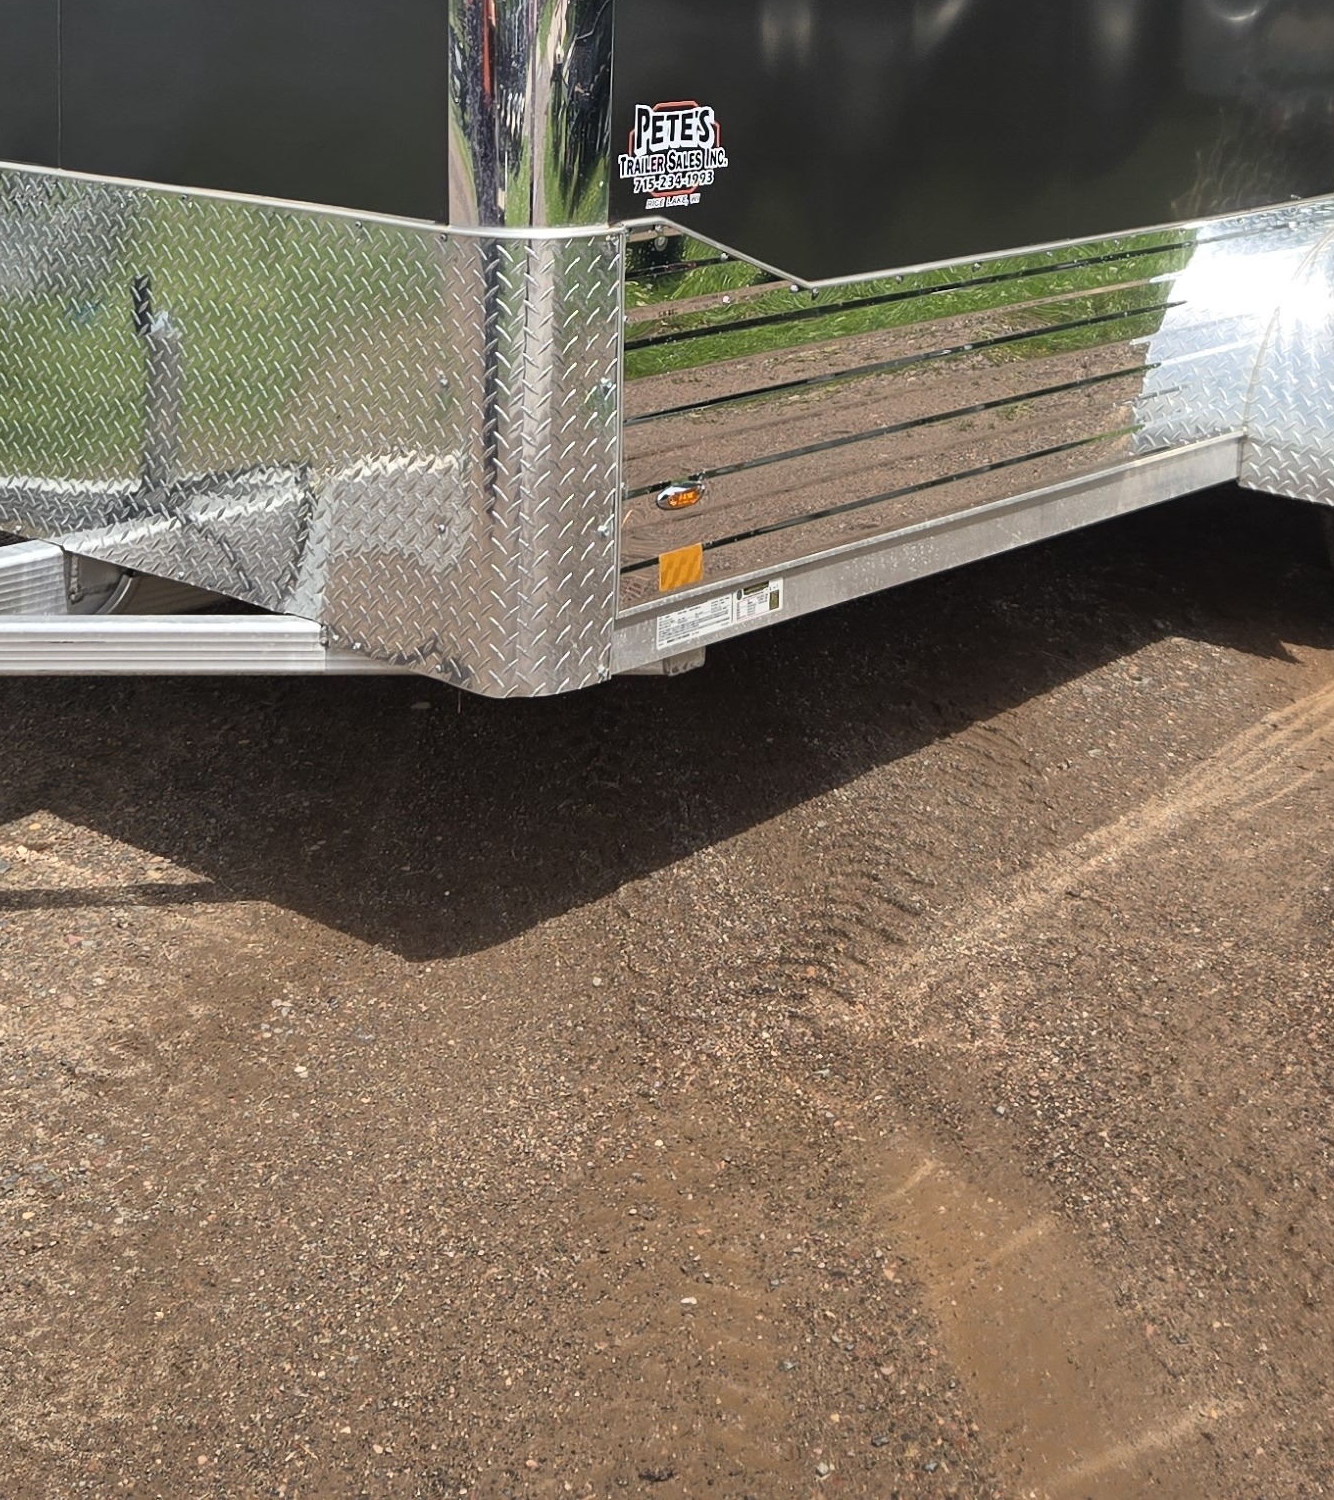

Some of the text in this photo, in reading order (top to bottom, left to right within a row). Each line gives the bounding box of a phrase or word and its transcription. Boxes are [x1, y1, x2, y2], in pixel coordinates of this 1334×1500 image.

[635, 106, 713, 153] PETE'S
[619, 148, 728, 178] TRAILER SALES INC.
[634, 170, 714, 192] 715-234-1993
[646, 198, 665, 208] RICE
